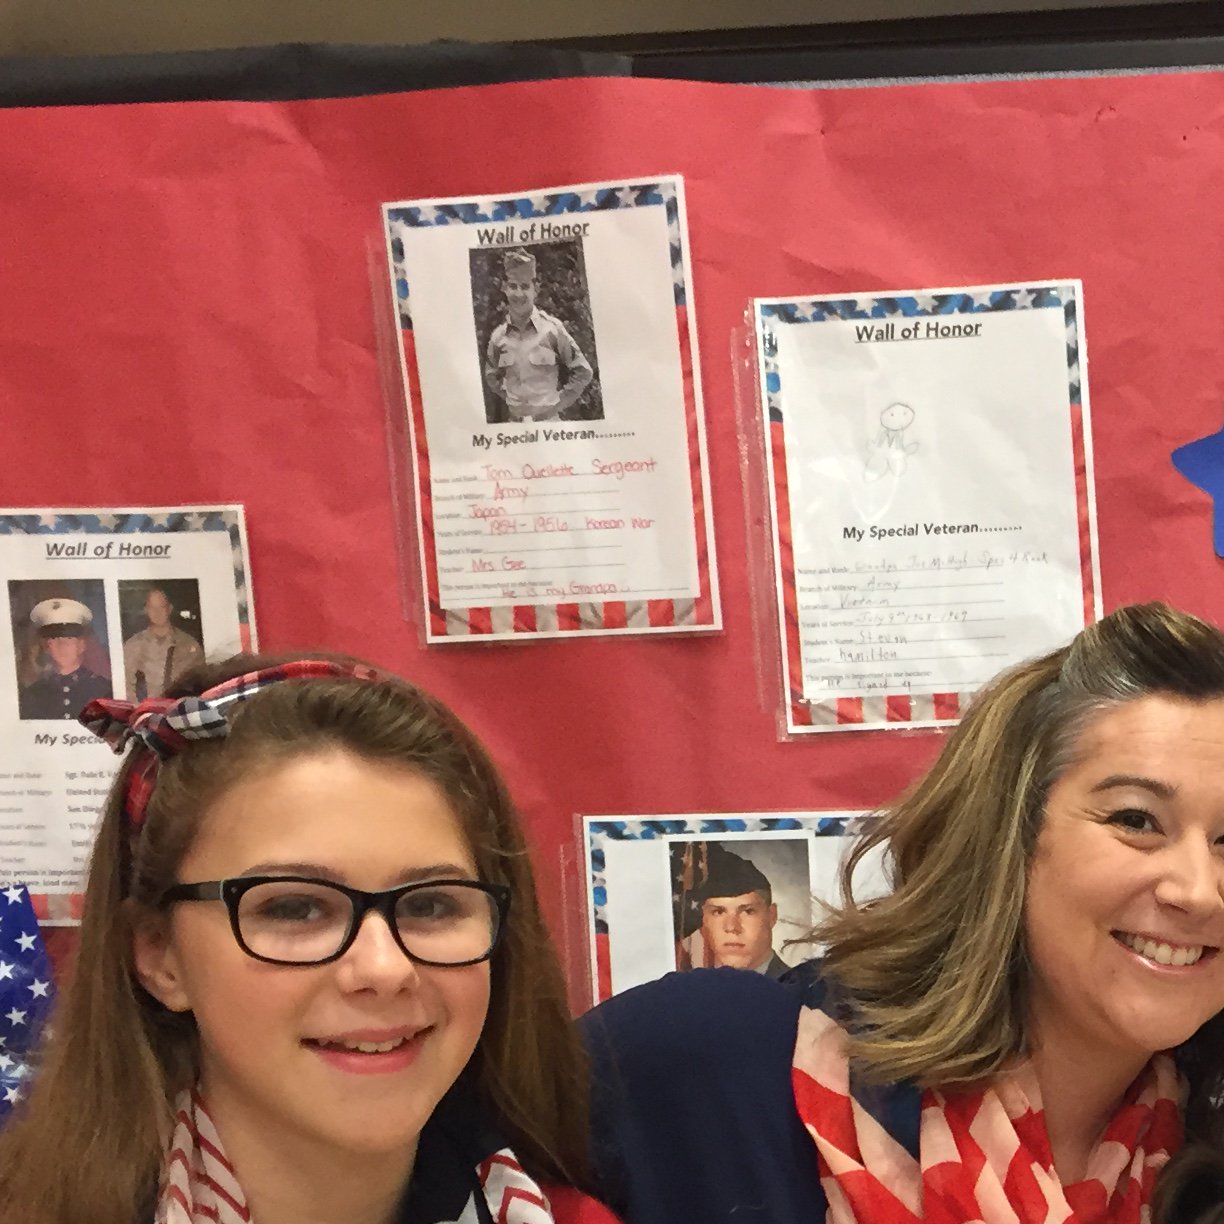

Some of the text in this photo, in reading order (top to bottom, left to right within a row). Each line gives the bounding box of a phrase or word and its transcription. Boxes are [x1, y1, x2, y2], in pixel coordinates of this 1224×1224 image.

[477, 222, 589, 245] Wall of Honor
[856, 322, 982, 341] Wall of Honor
[473, 435, 492, 449] My
[497, 430, 539, 447] Special
[482, 459, 657, 480] Tom Sergeant
[494, 482, 528, 503] Army
[468, 504, 506, 519] Japan
[586, 517, 625, 529] Korean
[843, 527, 863, 542] My
[870, 524, 918, 540] Special
[46, 542, 171, 559] Wall of Honor
[472, 559, 494, 572] Mrs
[35, 734, 105, 746] My Specia
